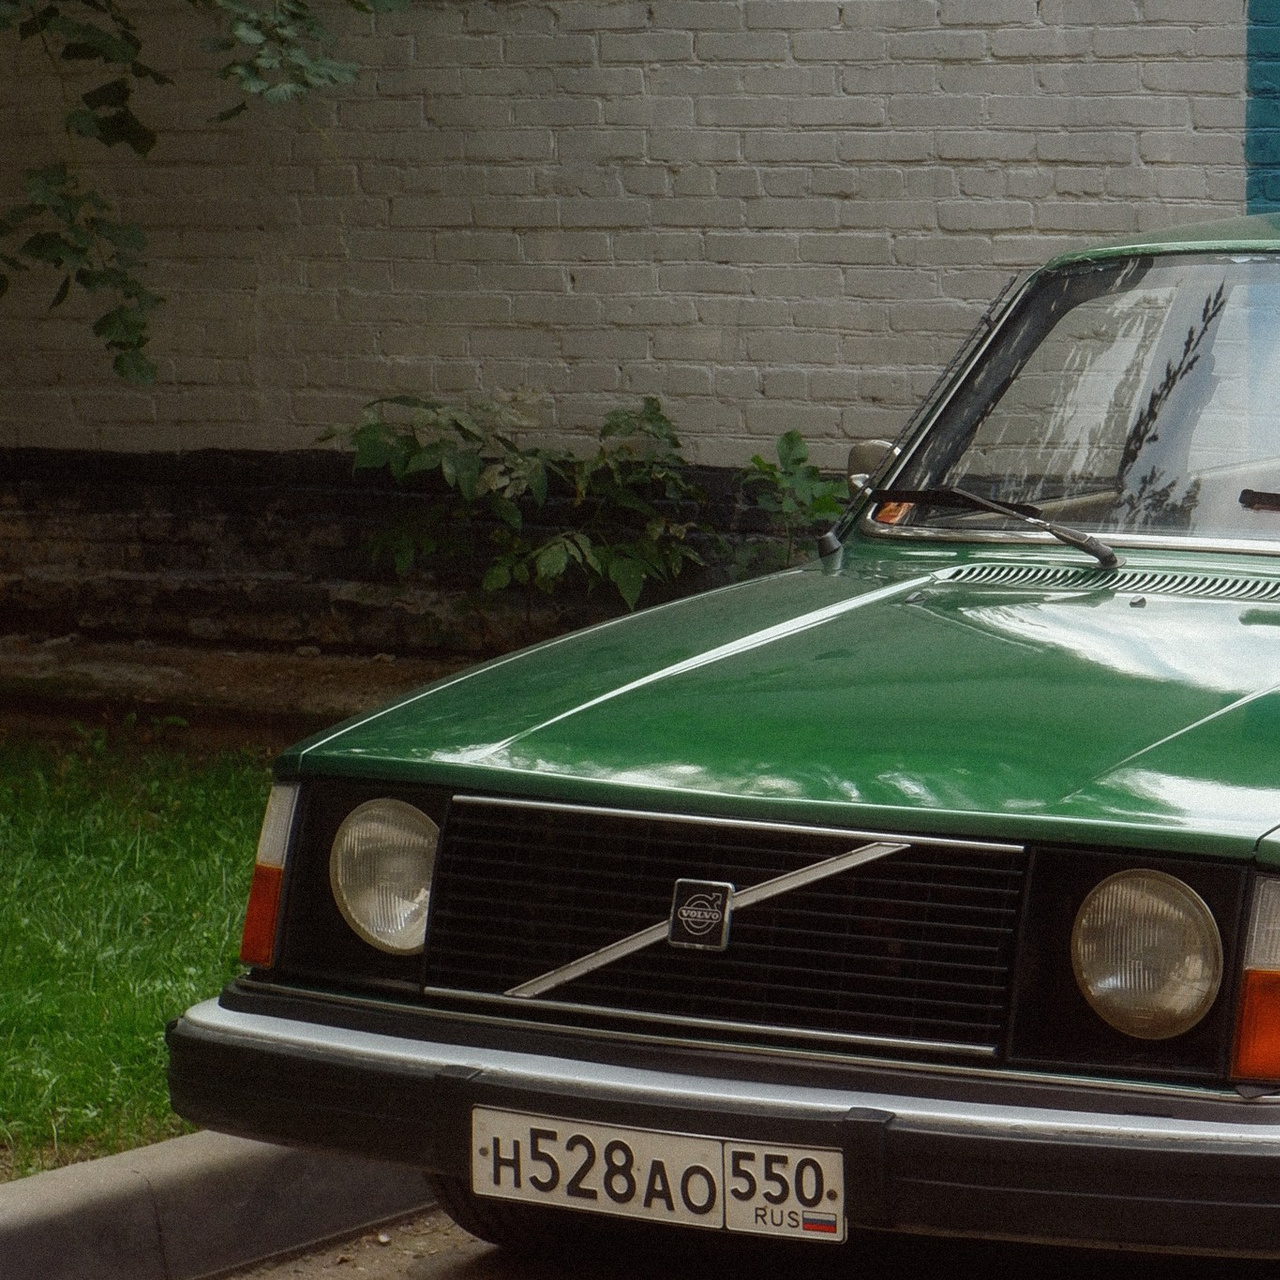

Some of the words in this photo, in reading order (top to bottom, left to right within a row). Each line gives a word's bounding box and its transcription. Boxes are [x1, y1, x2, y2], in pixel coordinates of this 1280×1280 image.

[680, 908, 720, 921] VOLVO
[729, 1150, 825, 1209] 550
[753, 1205, 801, 1230] RUS
